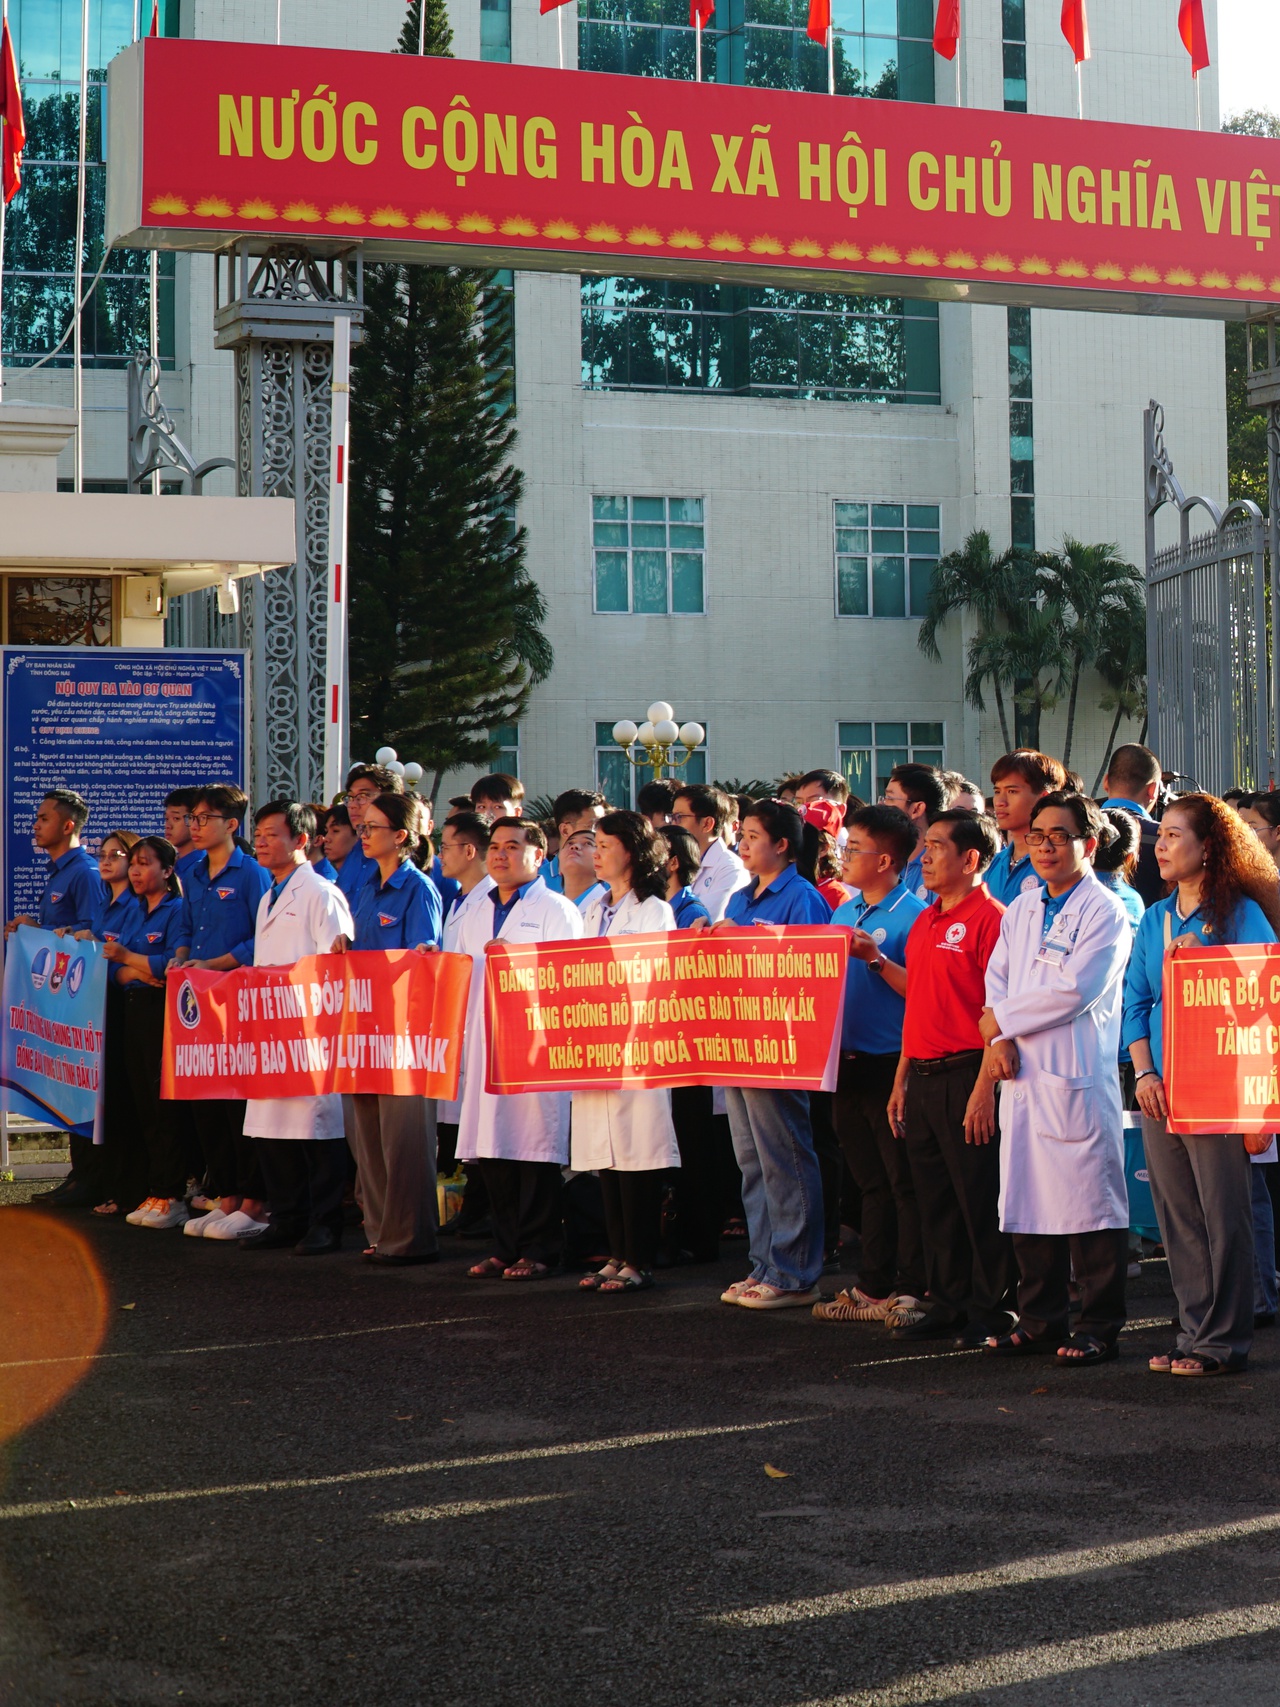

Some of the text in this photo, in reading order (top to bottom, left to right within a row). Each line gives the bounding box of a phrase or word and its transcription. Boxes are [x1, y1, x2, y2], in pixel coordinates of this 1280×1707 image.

[218, 84, 378, 165] NƯỚC
[402, 94, 558, 187] CỘNG
[580, 110, 694, 191] HÒA
[710, 123, 780, 198] XÃ
[798, 131, 887, 218] HỘI
[907, 139, 1012, 217] CHỦ
[1032, 158, 1182, 231] NGHĨA
[55, 679, 192, 697] NỘI QUY RA VÀO CƠ QUAN
[499, 945, 839, 994] ĐẢNG BỘ, CHÍNH QUYỀN VÀ NHÂN DÂN TỈNH ĐỒNG NAI
[1183, 967, 1230, 1008] ĐẢNG
[1236, 968, 1265, 1009] BỘ,
[237, 979, 249, 1022] SỞ
[250, 988, 258, 1020] Y
[260, 975, 274, 1020] TẾ
[273, 976, 308, 1019] TỈNH
[349, 978, 373, 1013] NAI
[525, 987, 816, 1031] TĂNG CƯỜNG HỖ TRỢ ĐỒNG BÀO TỈNH ĐẮK LẮK
[175, 1037, 215, 1077] HƯỚNG
[216, 1032, 228, 1076] VỀ
[229, 1031, 257, 1076] ĐỒNG
[260, 1033, 287, 1075] BÀO
[287, 1031, 329, 1073] VÙNG
[337, 1034, 366, 1078] LỤT
[548, 1031, 797, 1072] KHẮC PHỤC HẬU QUẢ THIÊN TAI, BÃO LŨ
[1216, 1019, 1261, 1056] TĂNG
